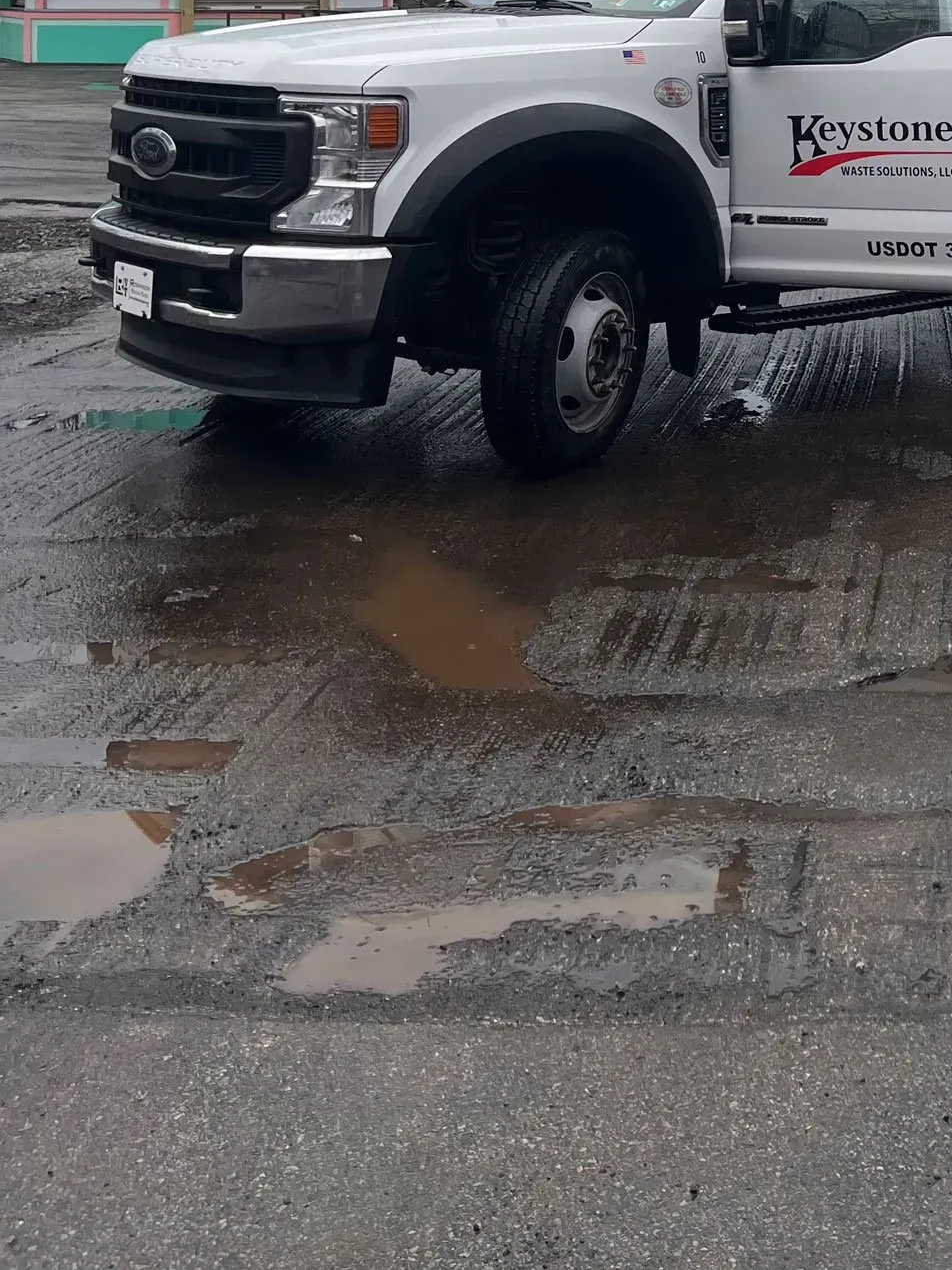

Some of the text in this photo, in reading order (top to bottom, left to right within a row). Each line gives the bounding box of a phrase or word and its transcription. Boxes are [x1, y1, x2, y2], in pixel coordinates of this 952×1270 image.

[695, 50, 706, 64] 10
[841, 166, 874, 177] WASTE
[876, 166, 937, 178] SOLUTIONS,
[867, 241, 938, 258] USDOT
